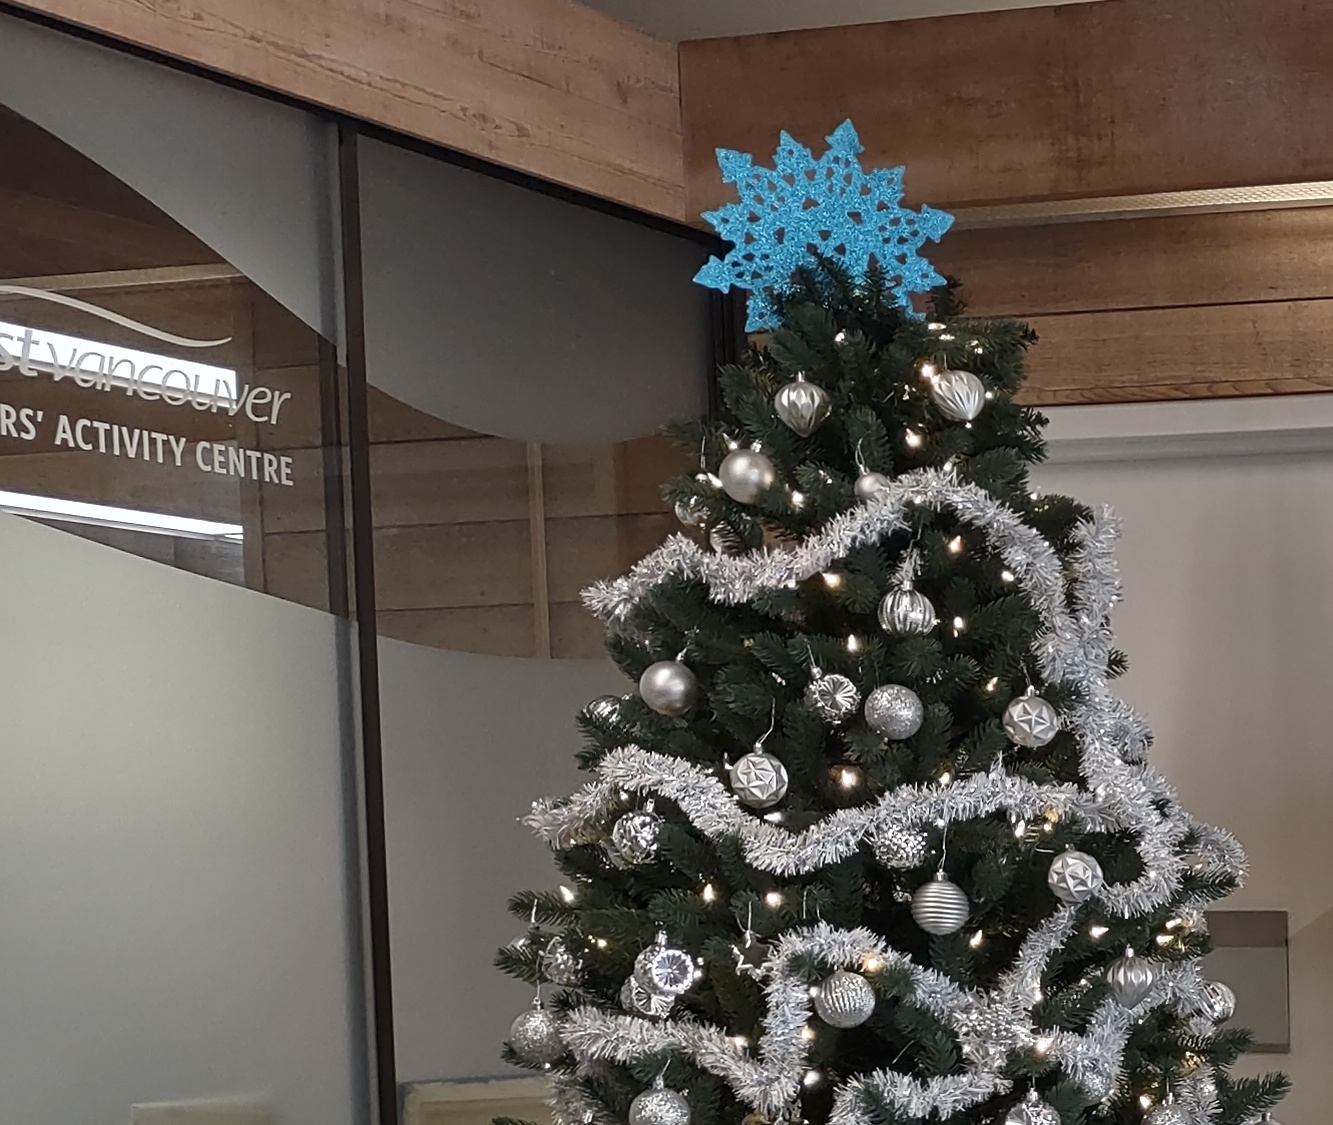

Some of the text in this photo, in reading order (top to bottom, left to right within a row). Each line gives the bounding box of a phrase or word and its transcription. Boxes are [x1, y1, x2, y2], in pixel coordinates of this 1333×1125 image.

[47, 342, 292, 425] vancouver
[55, 414, 187, 467] ACTIVITY
[196, 440, 295, 486] CENTRE
